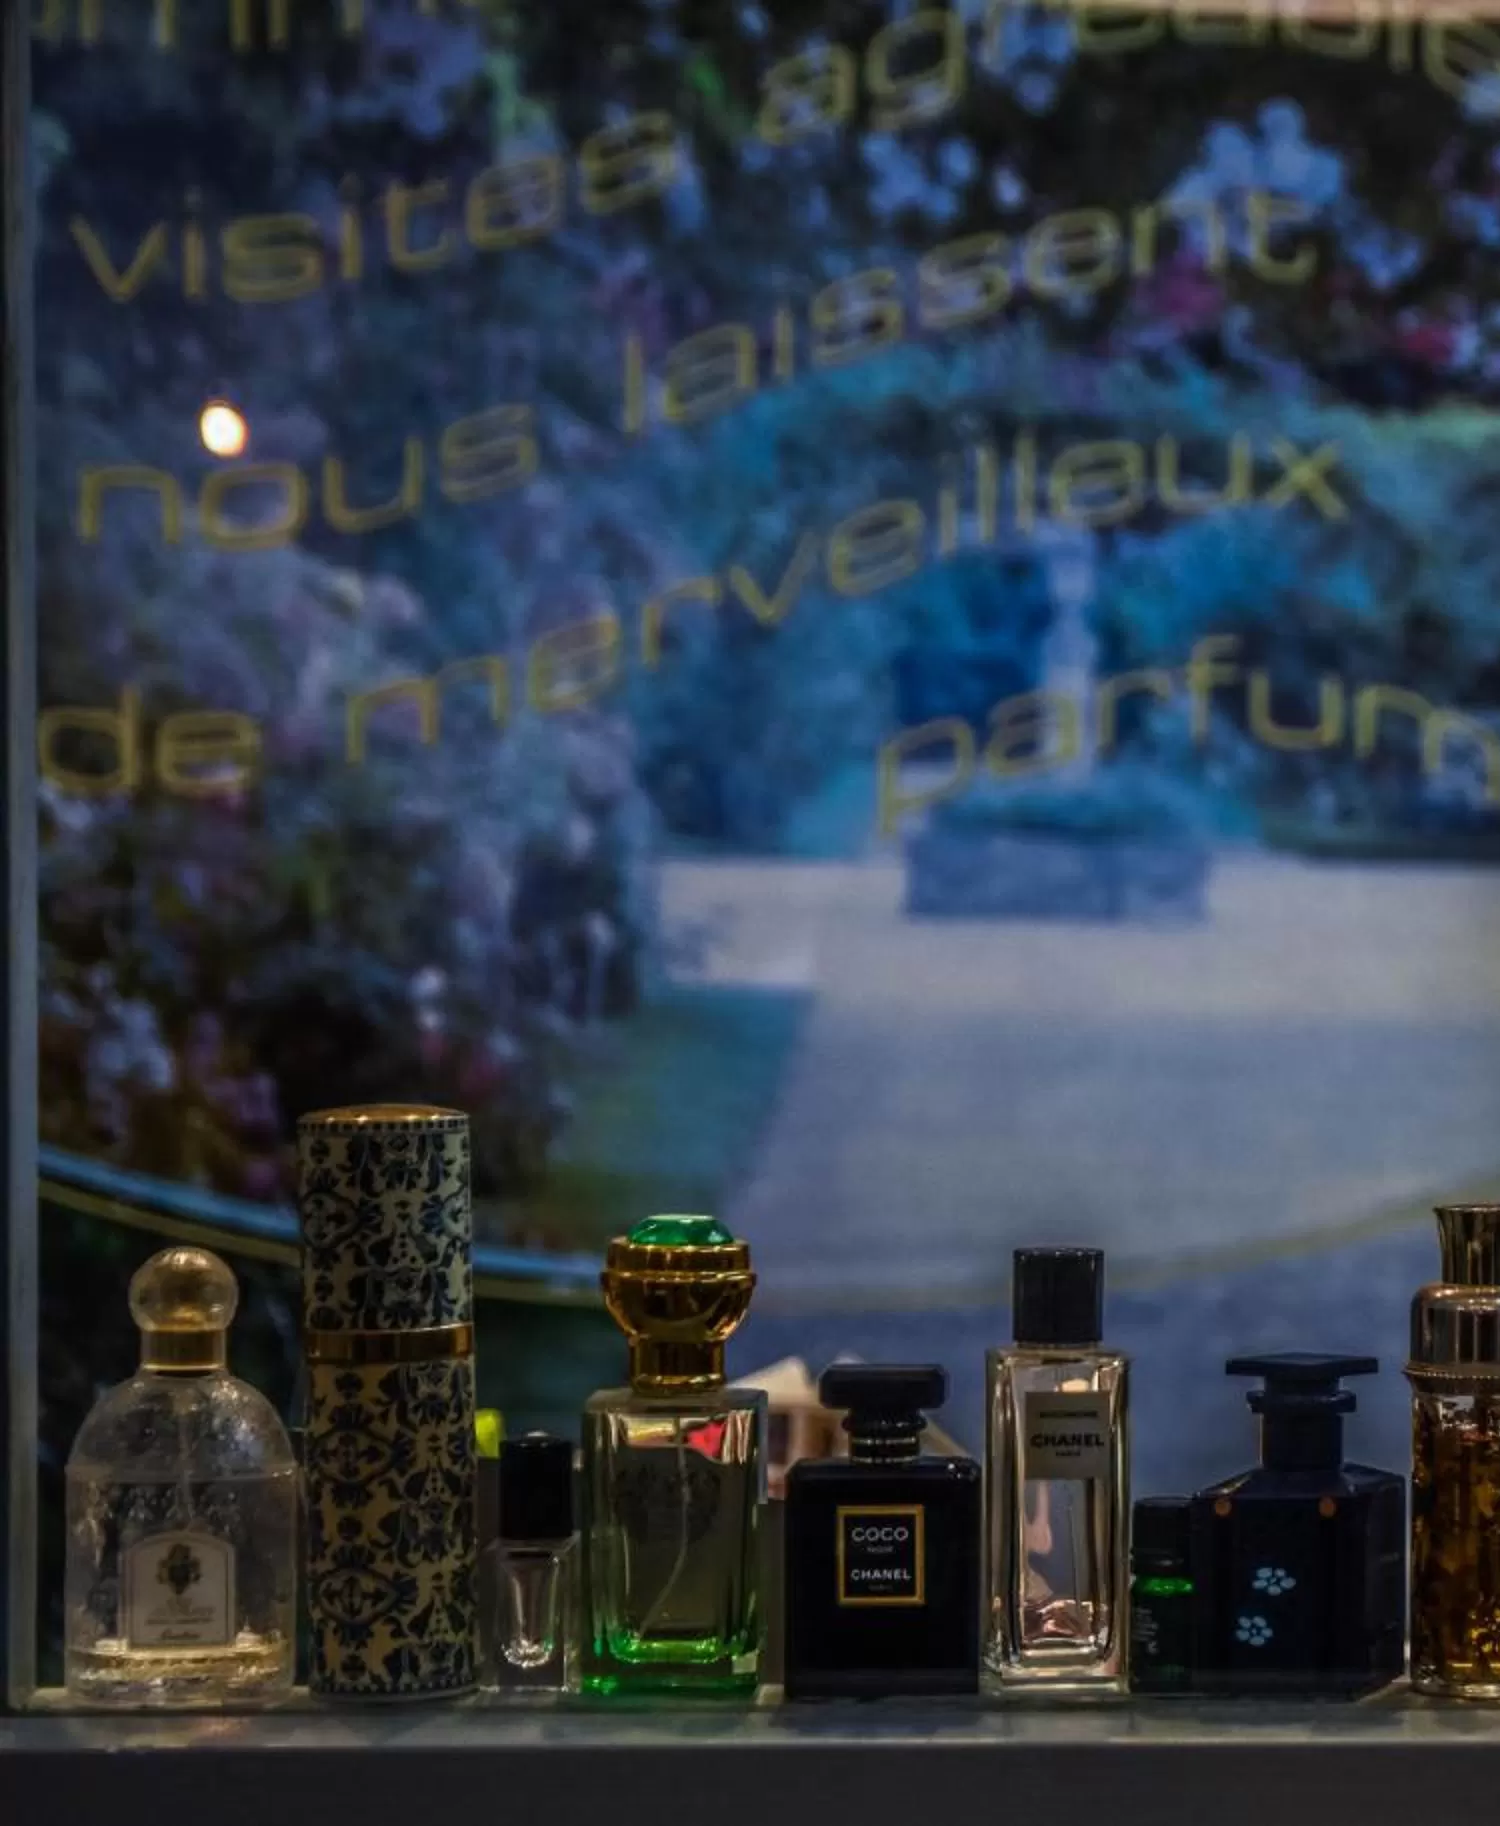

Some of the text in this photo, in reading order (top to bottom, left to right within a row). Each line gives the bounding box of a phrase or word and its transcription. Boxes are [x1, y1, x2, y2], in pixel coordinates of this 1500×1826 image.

[76, 188, 1320, 550] nous laissent
[37, 425, 1350, 798] de merveilleux
[1030, 1432, 1105, 1449] CHANEL
[850, 1525, 909, 1543] COCO
[850, 1567, 913, 1582] CHANEL
